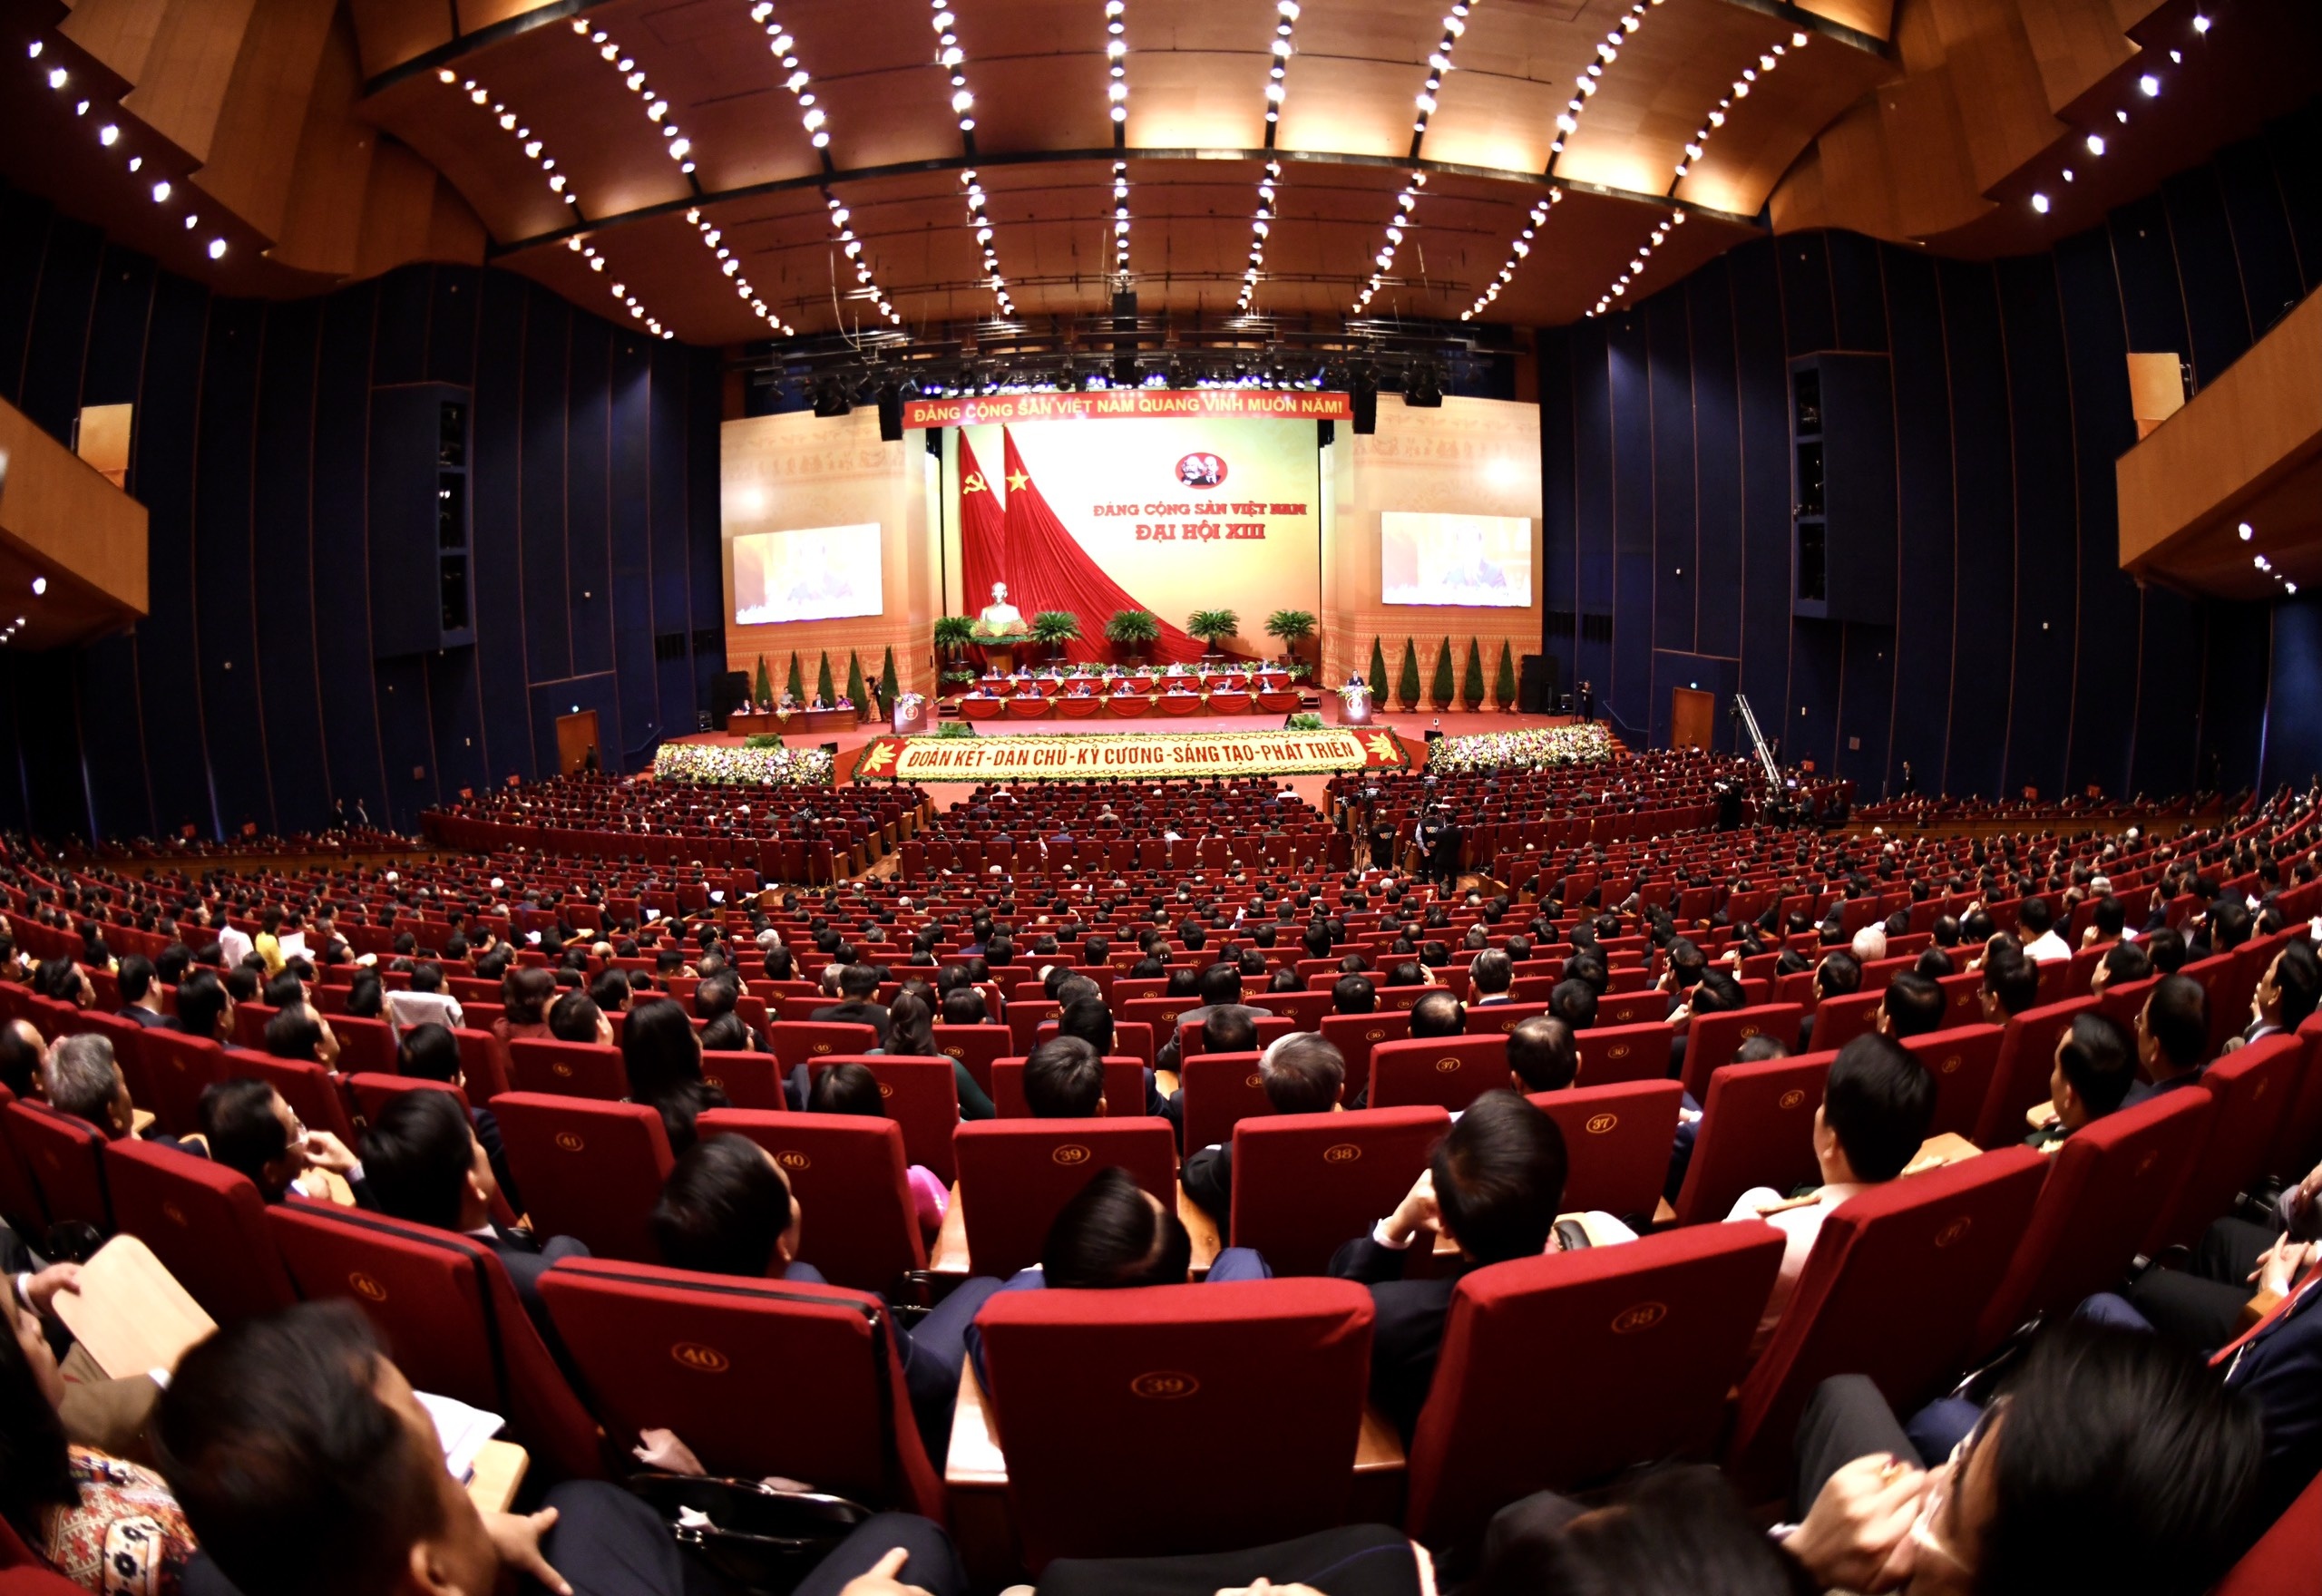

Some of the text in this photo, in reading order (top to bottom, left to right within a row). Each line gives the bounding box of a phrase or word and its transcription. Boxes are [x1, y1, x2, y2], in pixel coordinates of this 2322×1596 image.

[914, 404, 961, 423] ĐẢNG
[965, 402, 1013, 421] CỘNG
[1098, 399, 1135, 414] NAM
[1138, 399, 1200, 414] QUANG
[1204, 397, 1244, 412] VINH
[1247, 396, 1297, 413] MUÔN
[1302, 397, 1342, 414] NĂM!
[1144, 501, 1191, 518] CỘNG
[1230, 501, 1267, 517] VIỆT
[1269, 503, 1307, 515] NAM
[1136, 520, 1265, 543] ĐẠI HỘI XIII
[1593, 1117, 1610, 1130] 37
[562, 1136, 578, 1148] 41
[783, 1154, 804, 1167] 40
[1059, 1148, 1081, 1161] 39
[1332, 1148, 1352, 1160] 38
[684, 1348, 718, 1367] 40
[1147, 1378, 1184, 1393] 39
